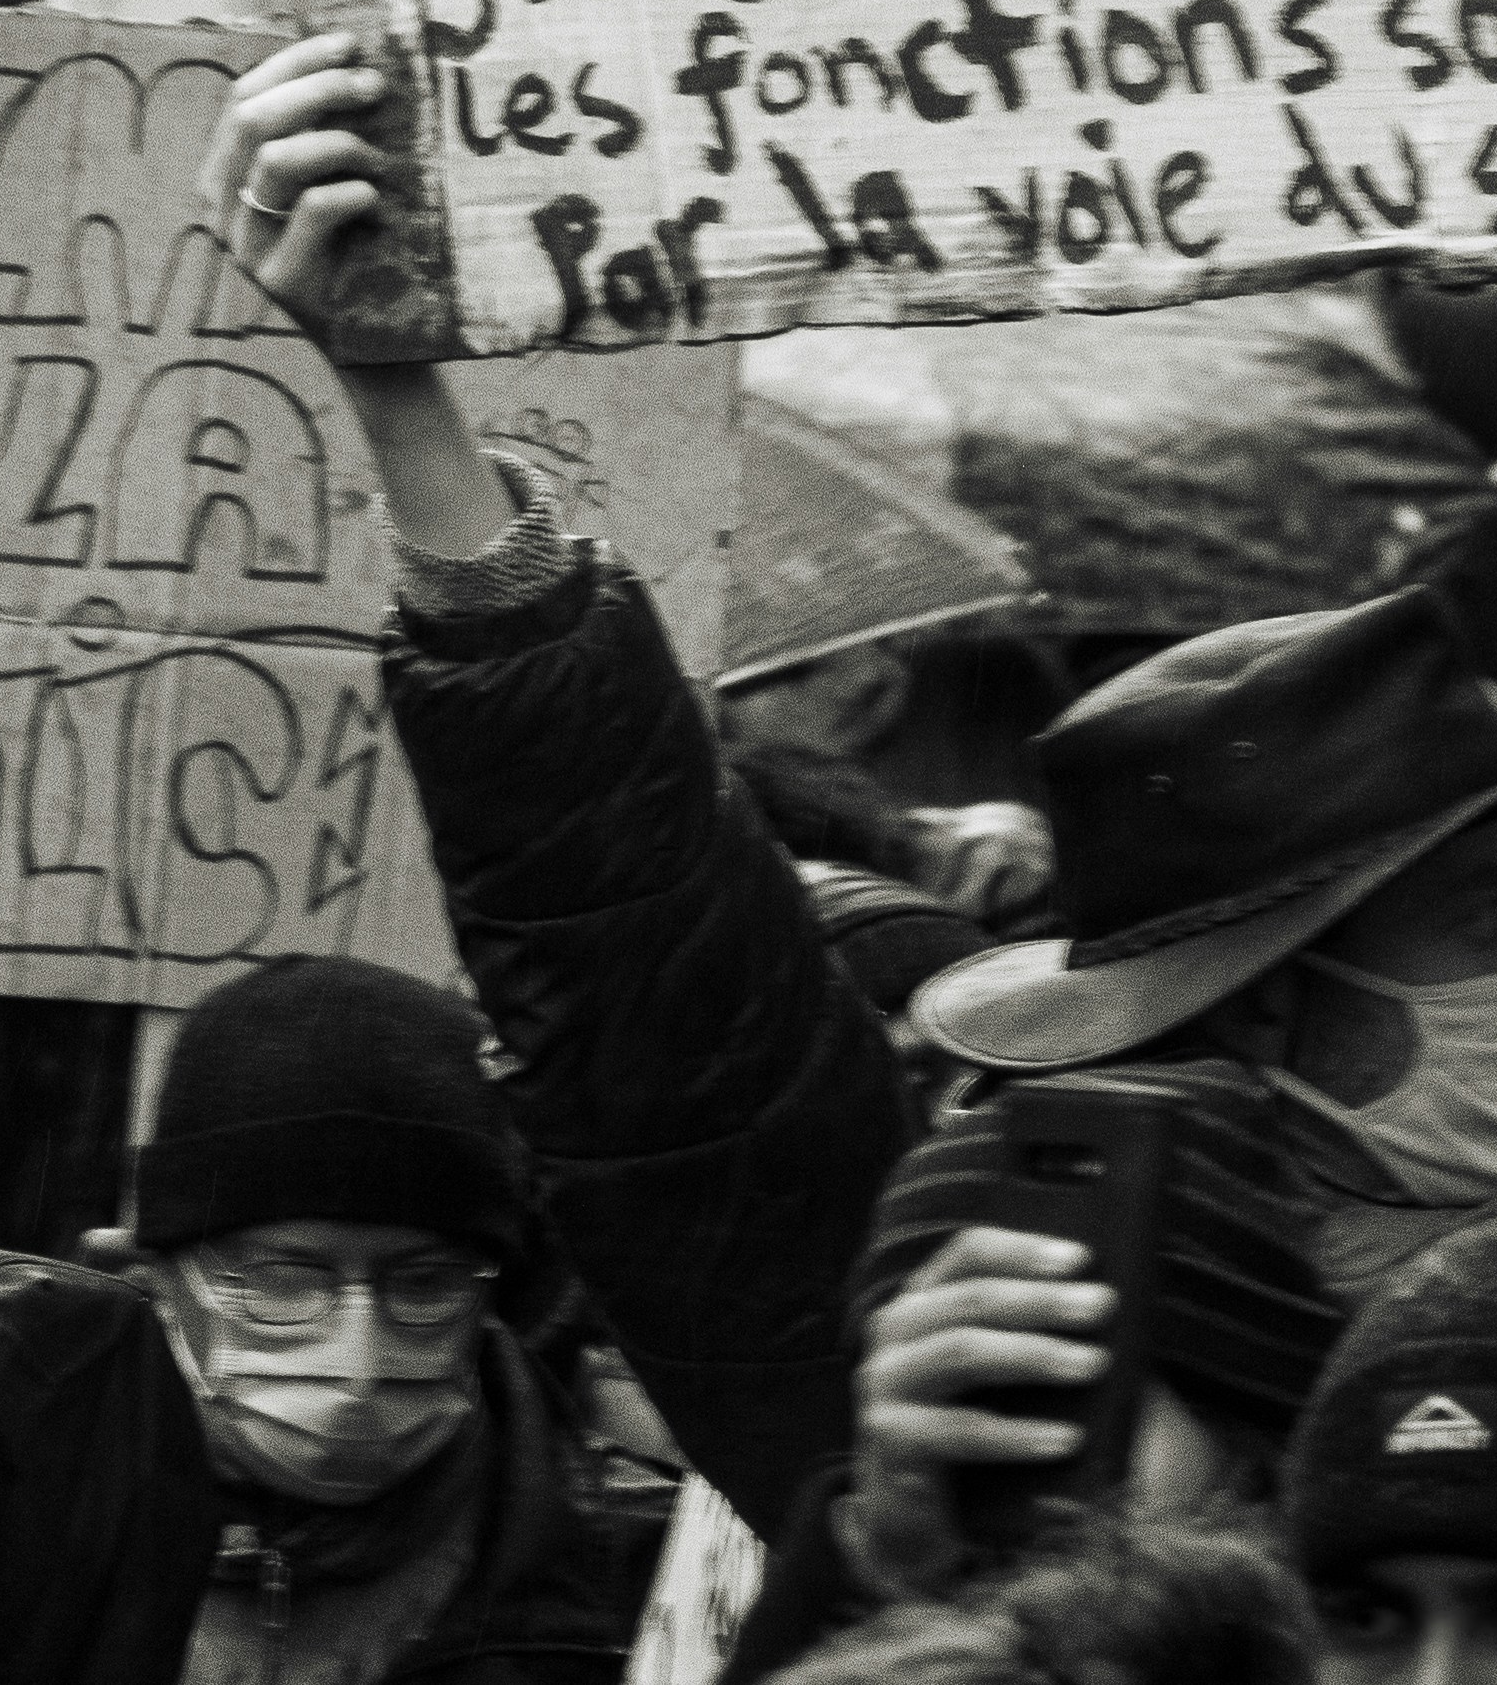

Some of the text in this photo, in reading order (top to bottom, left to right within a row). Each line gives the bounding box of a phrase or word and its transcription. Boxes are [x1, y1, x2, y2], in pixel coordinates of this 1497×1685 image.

[762, 141, 941, 271] la
[971, 119, 1220, 265] voie
[1281, 102, 1425, 235] du
